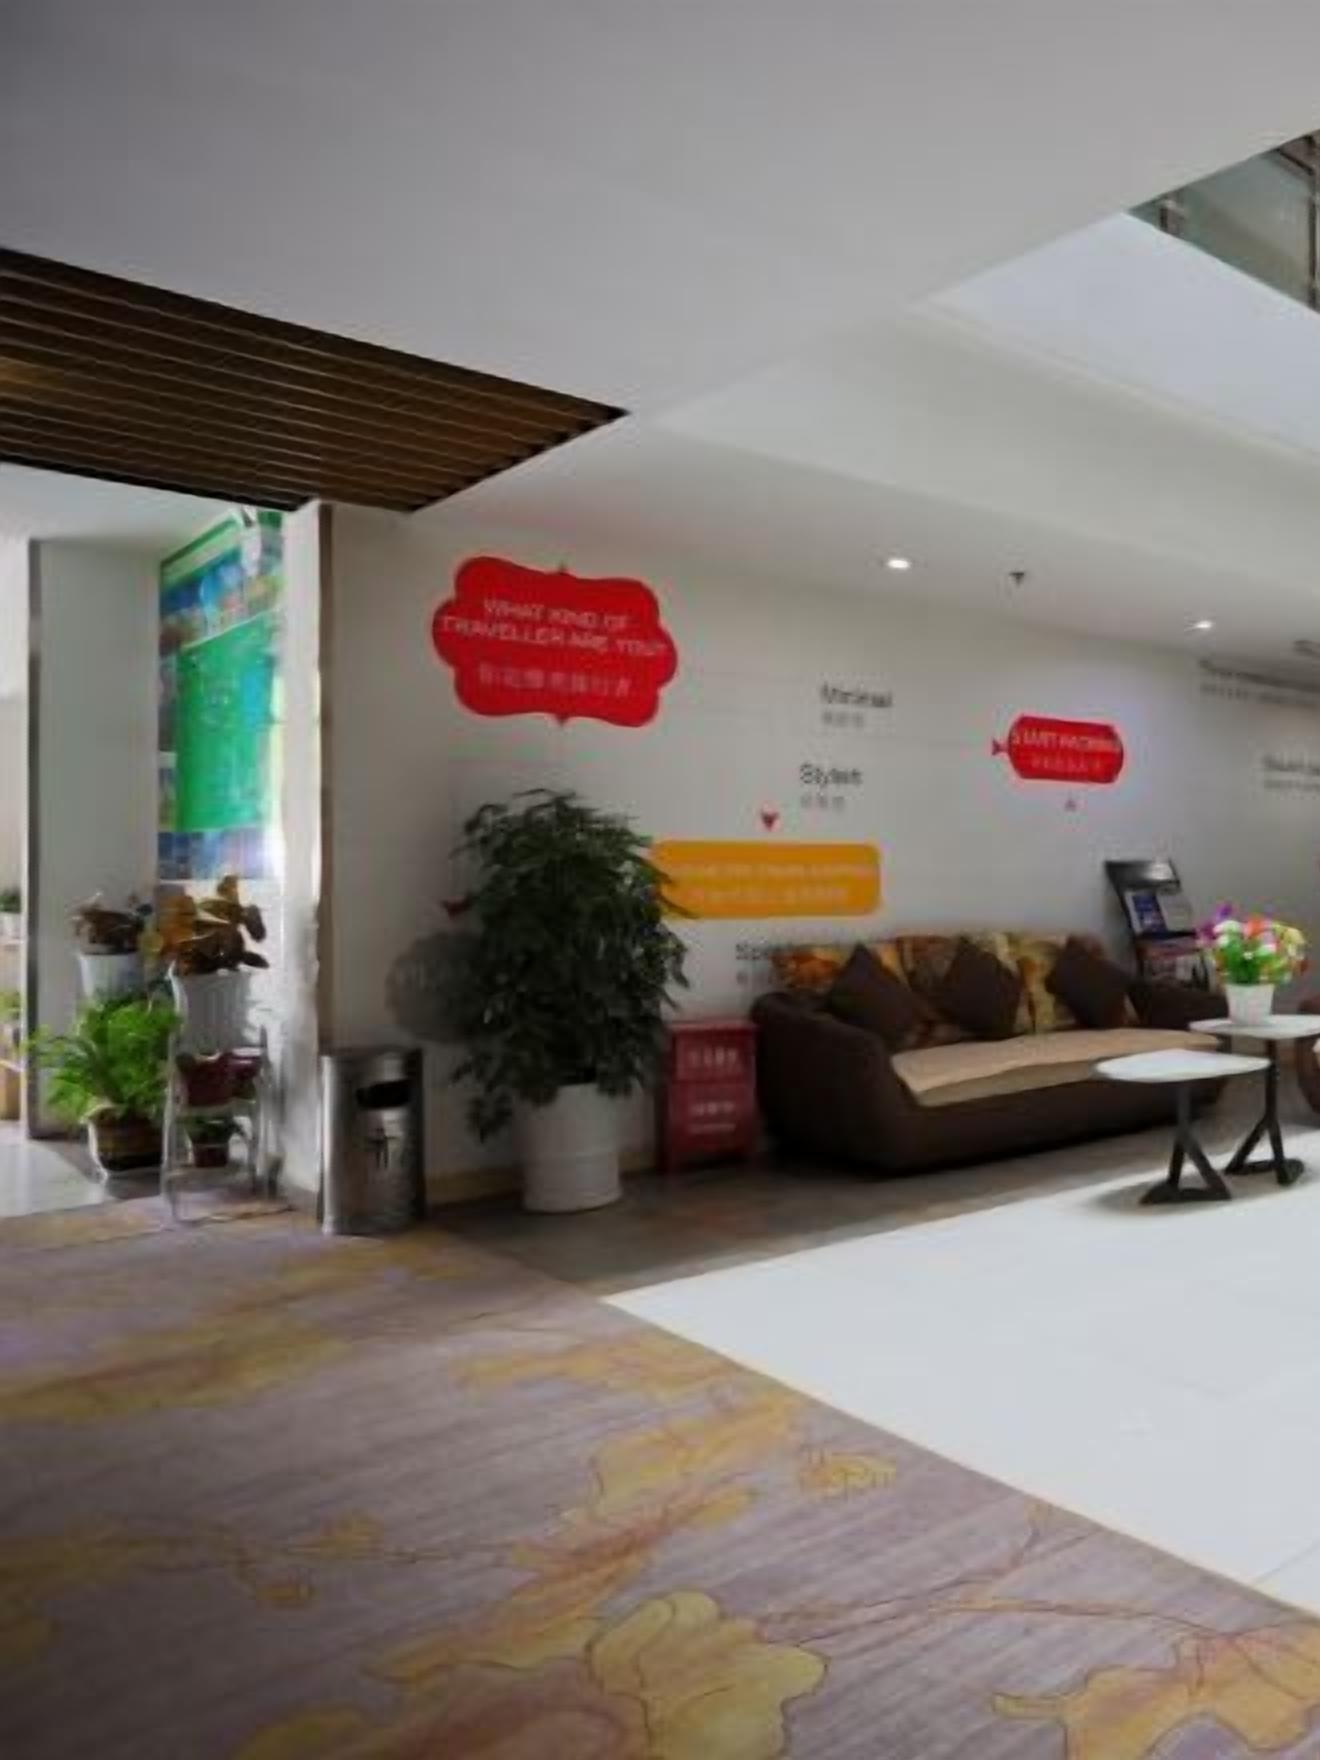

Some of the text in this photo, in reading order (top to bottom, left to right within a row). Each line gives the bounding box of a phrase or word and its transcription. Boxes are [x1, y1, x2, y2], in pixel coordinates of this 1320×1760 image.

[483, 599, 629, 632] WHAT KIND OF
[443, 615, 565, 646] TRAVELLER
[569, 632, 610, 653] ARE
